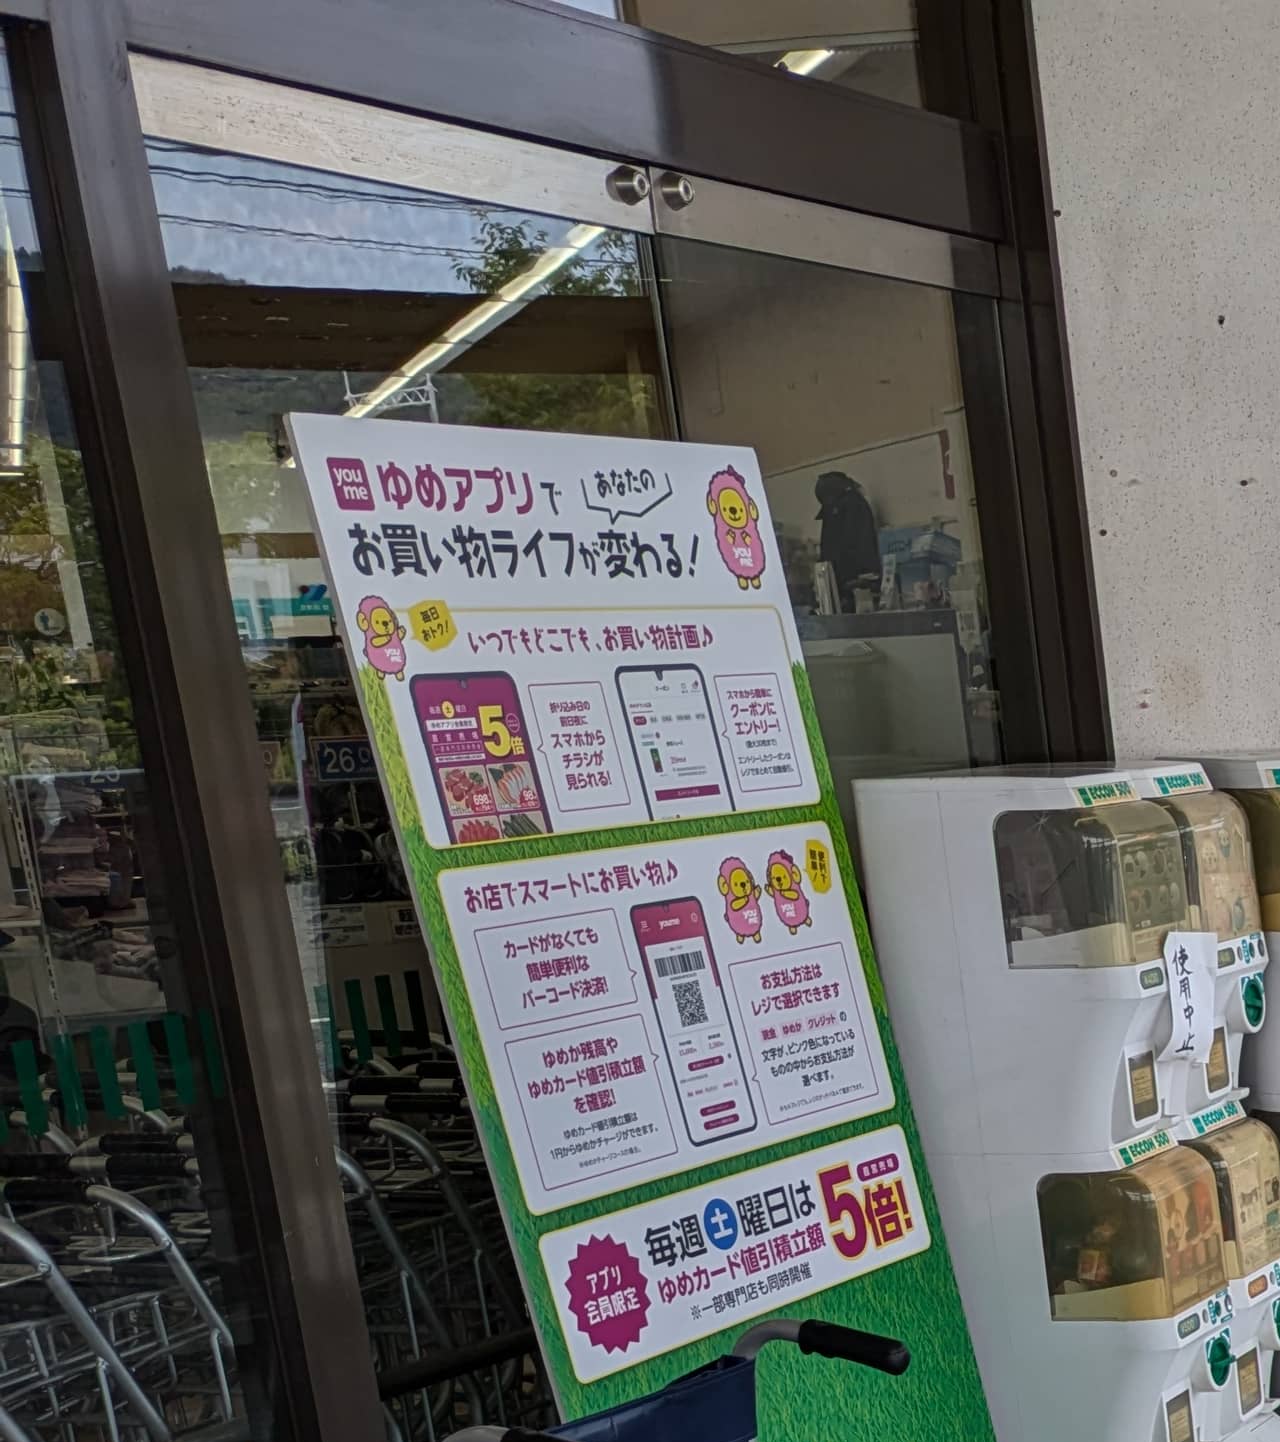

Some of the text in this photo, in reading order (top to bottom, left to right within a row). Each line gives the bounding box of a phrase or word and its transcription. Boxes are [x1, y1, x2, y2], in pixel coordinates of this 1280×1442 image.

[333, 467, 361, 486] you
[377, 461, 562, 515] ゆめアプリで
[594, 469, 656, 498] あなたの
[344, 484, 368, 500] me
[420, 606, 440, 623] 毎日
[730, 702, 776, 719] クーポンに
[551, 730, 606, 748] スマホから
[562, 751, 604, 769] チラシが
[504, 927, 599, 960] カードがなくても
[526, 954, 590, 983] 簡単便利な
[760, 963, 823, 991] お支払方法は
[751, 982, 840, 1016] レジで選択できます
[1171, 944, 1195, 1054] 使用中止
[542, 1036, 619, 1069] ゆめか残高や
[527, 1055, 647, 1100] ゆめカード値引積立額
[643, 1179, 816, 1268] 毎週土曜日は
[657, 1221, 826, 1305] ゆめカード値引積立額
[586, 1264, 623, 1294] アプリ
[584, 1287, 641, 1326] 会員限定
